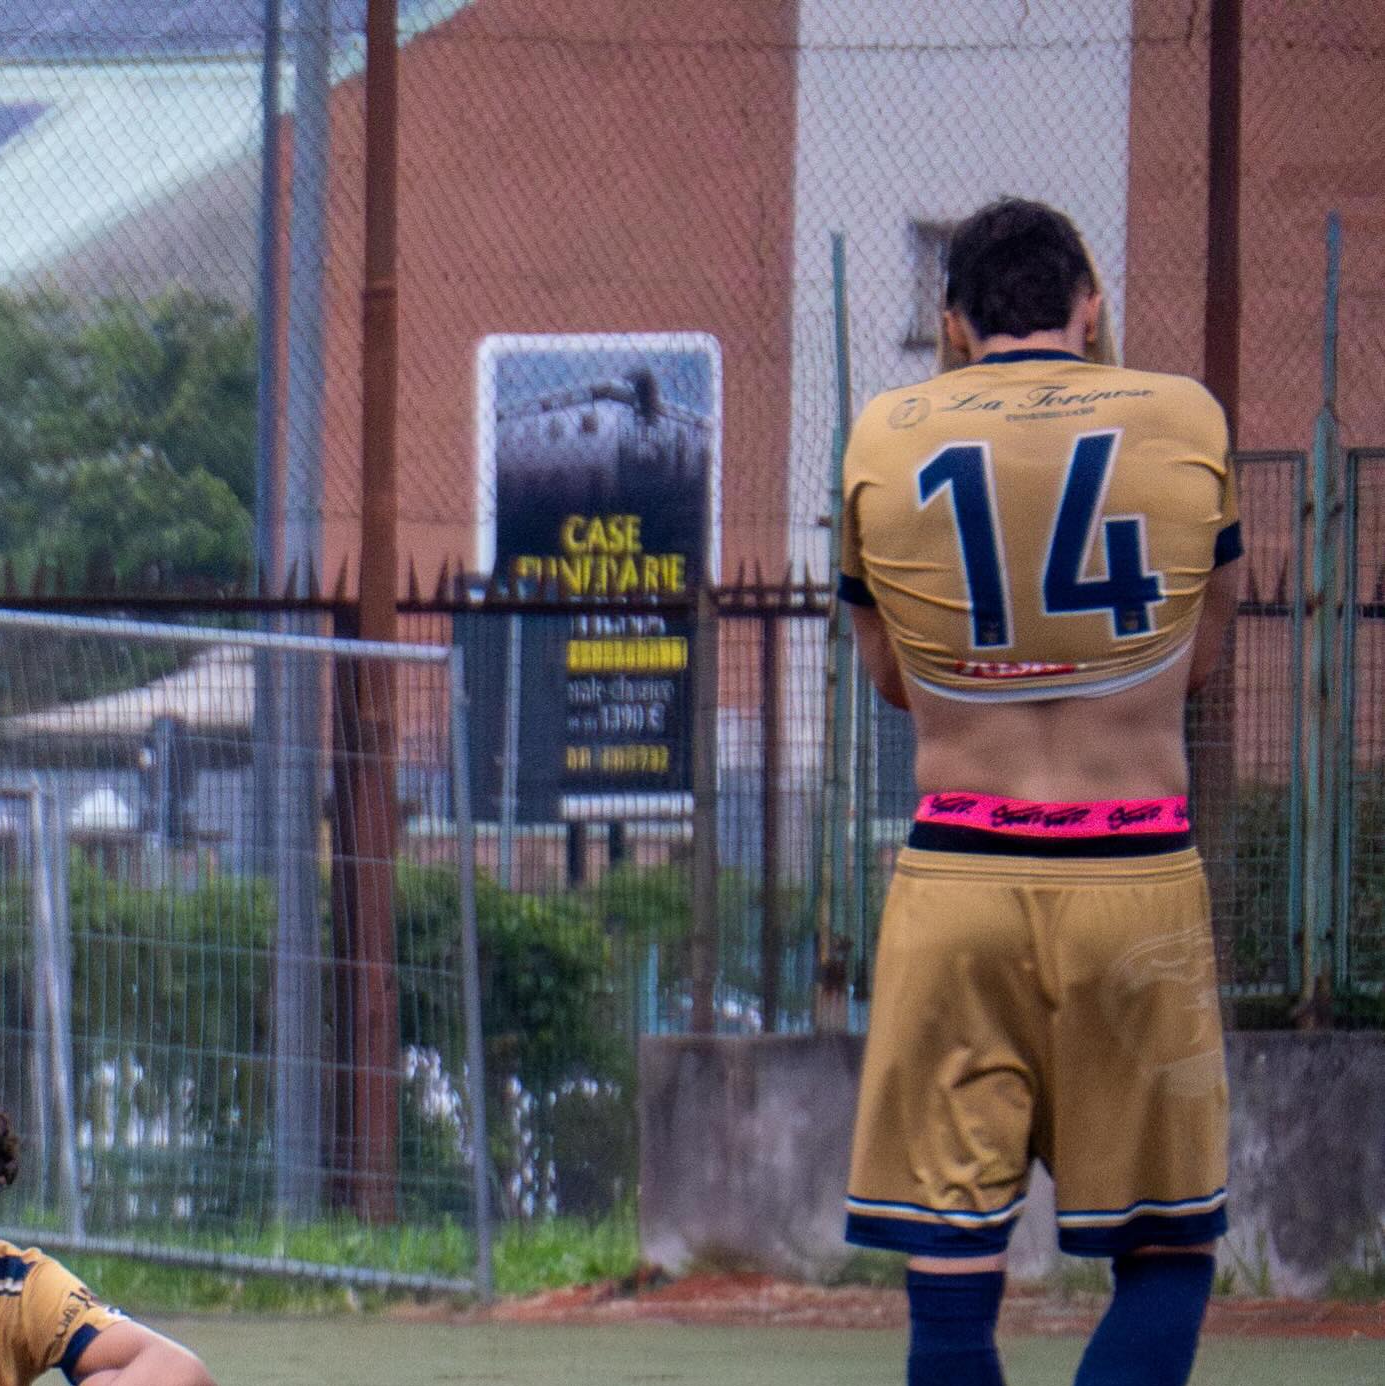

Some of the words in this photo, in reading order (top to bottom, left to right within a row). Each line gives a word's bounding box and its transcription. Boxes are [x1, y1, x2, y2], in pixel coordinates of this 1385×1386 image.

[941, 391, 1004, 411] La
[561, 514, 643, 553] CASE
[914, 427, 1167, 650] 14
